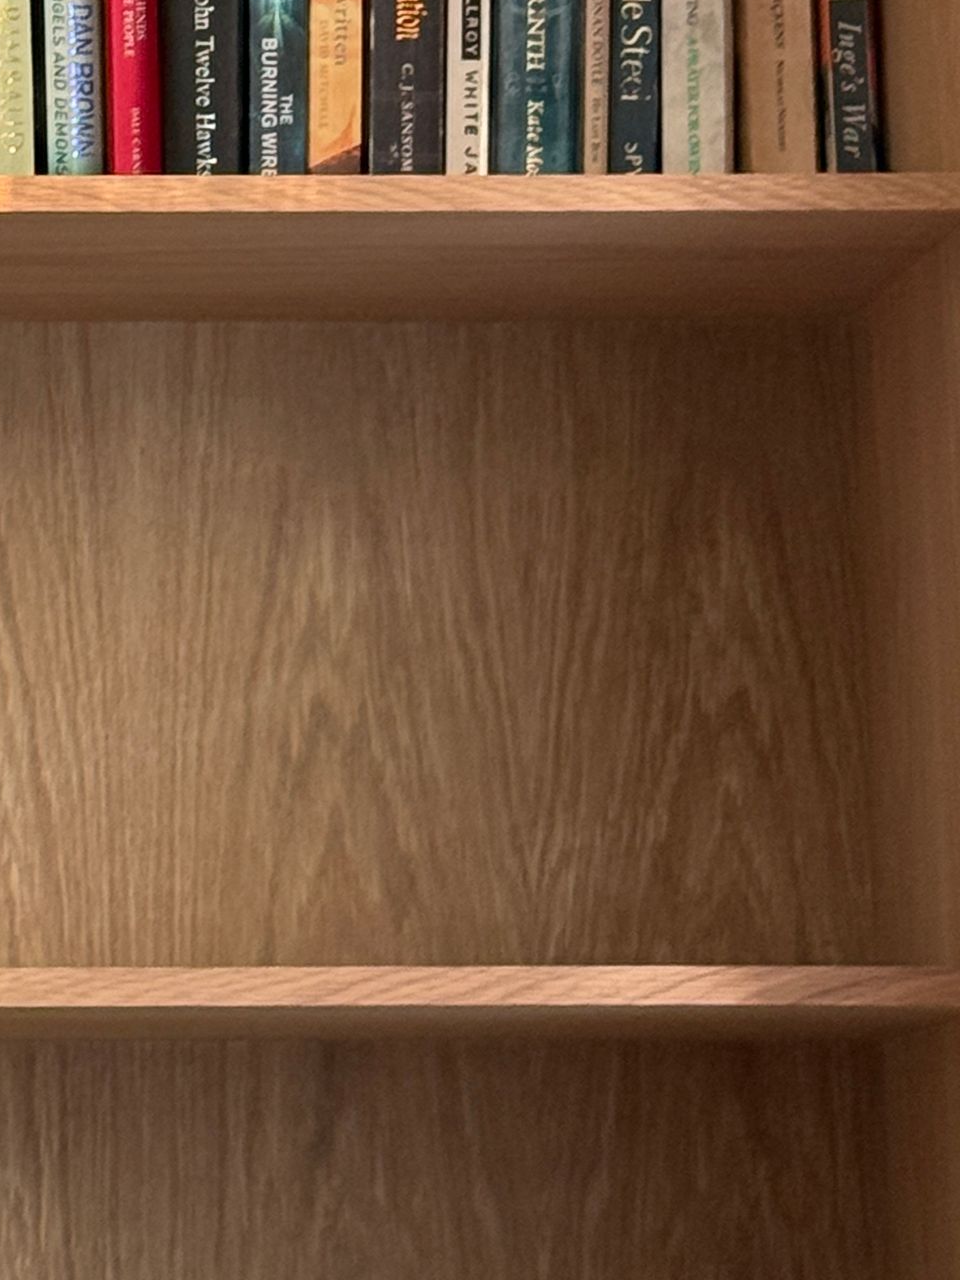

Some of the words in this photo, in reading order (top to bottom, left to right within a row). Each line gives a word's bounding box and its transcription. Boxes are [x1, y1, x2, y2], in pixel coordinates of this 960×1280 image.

[68, 3, 94, 56] DAN
[123, 10, 135, 57] PEOPLE
[52, 51, 67, 90] AND
[195, 36, 215, 107] Twelve
[261, 38, 278, 127] BURNING
[401, 63, 415, 80] C.
[591, 41, 604, 88] DOYLE
[832, 21, 865, 93] Inge's
[69, 62, 95, 160] BROWN
[279, 95, 293, 124] THE
[398, 83, 414, 96] J.
[464, 71, 479, 136] WHITE
[54, 97, 69, 175] DEMONS
[131, 107, 141, 134] DALE
[196, 113, 217, 175] Hawks
[400, 101, 415, 171] SANSOM
[526, 100, 544, 143] Kate
[841, 104, 866, 158] War
[261, 132, 278, 176] WIRE
